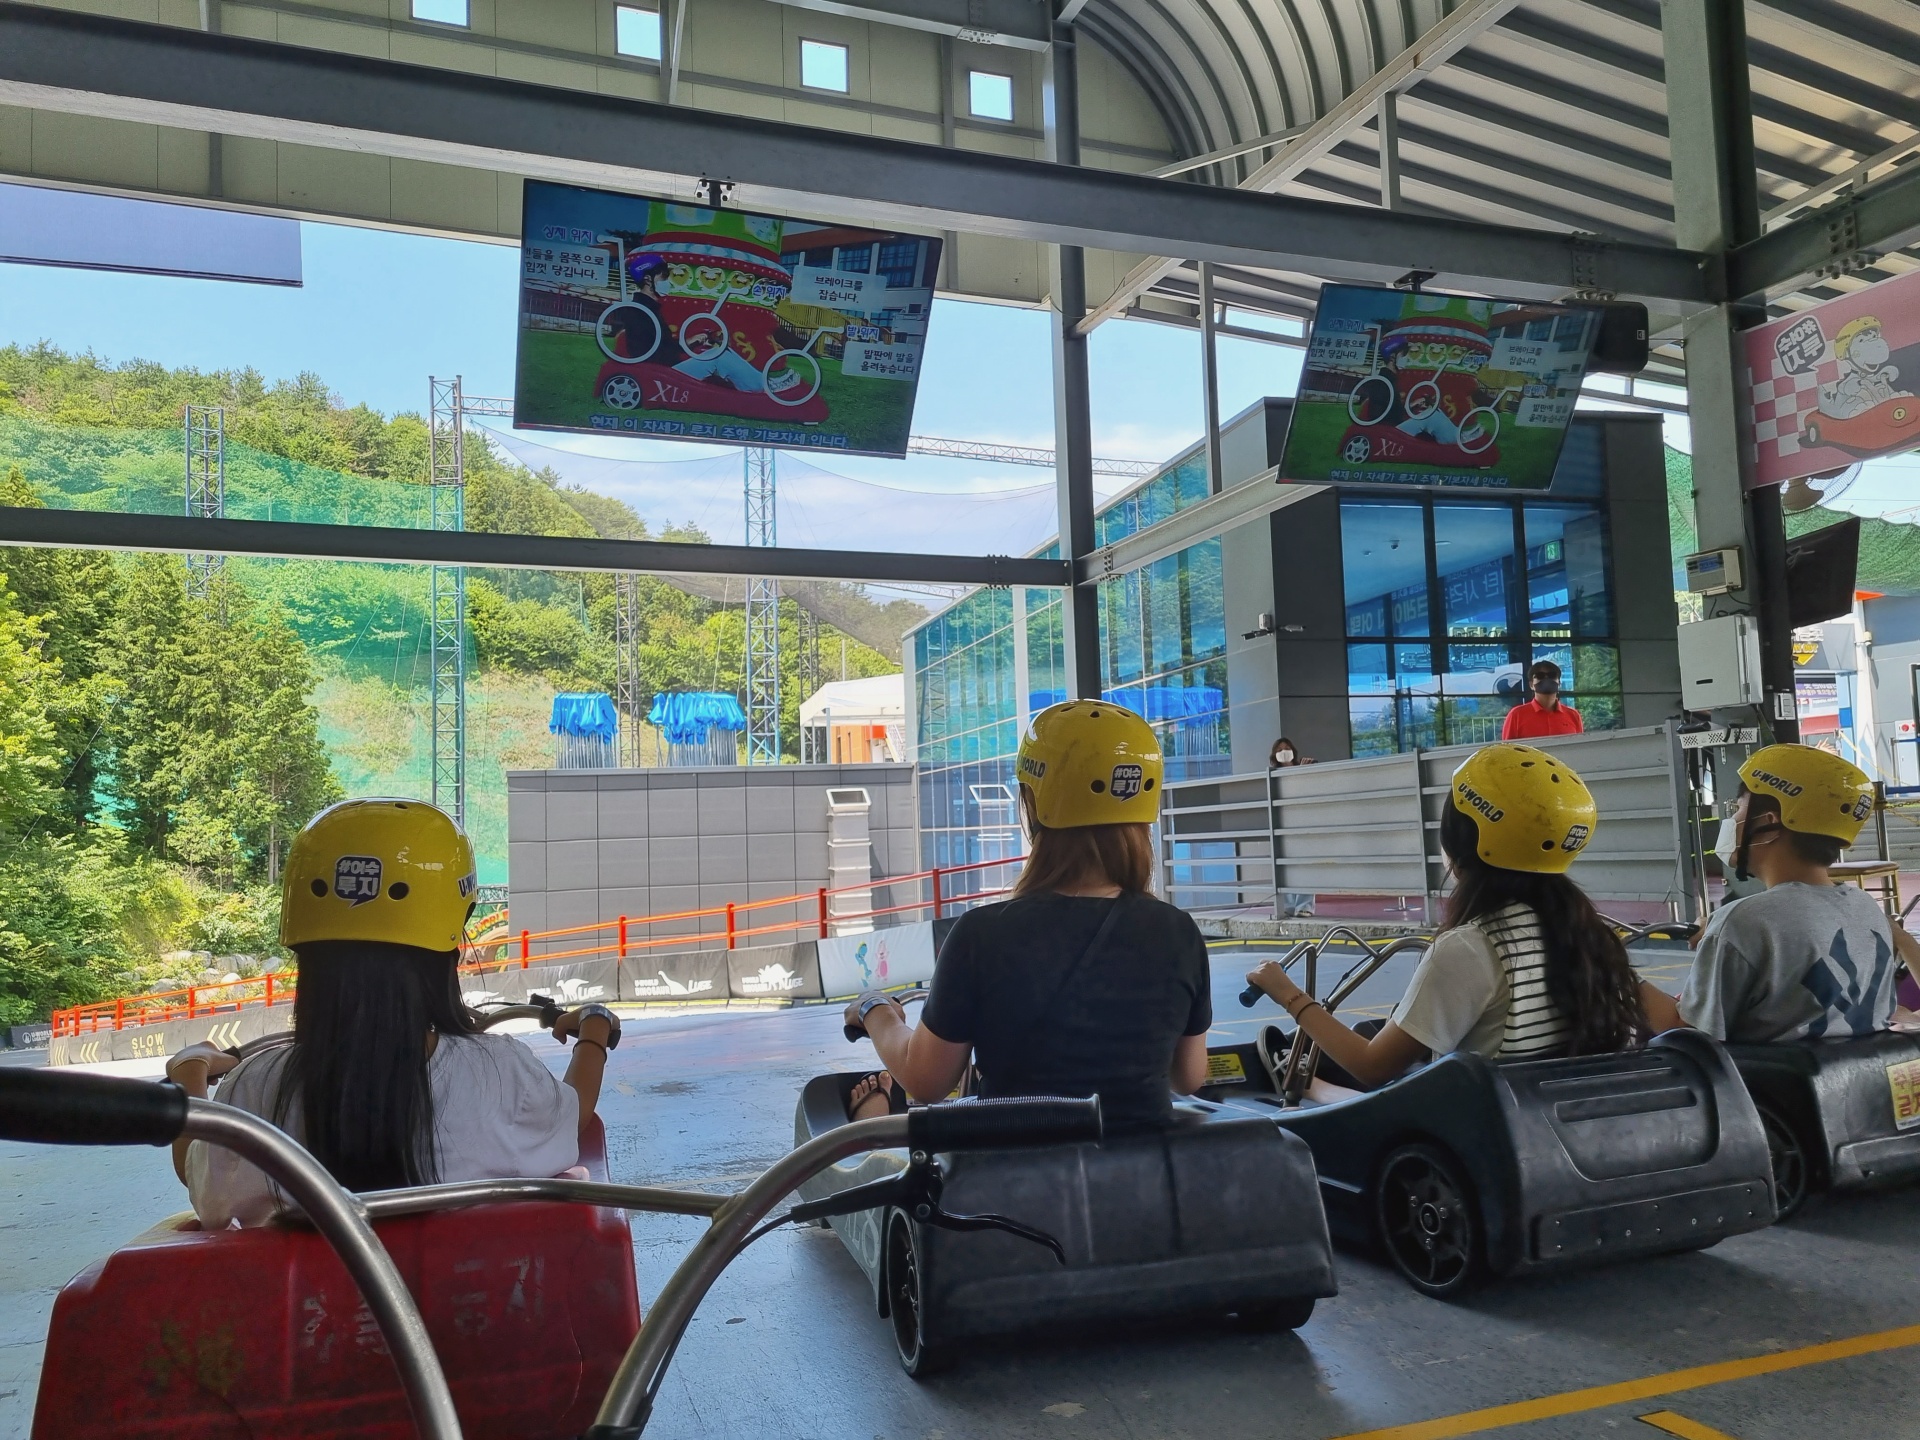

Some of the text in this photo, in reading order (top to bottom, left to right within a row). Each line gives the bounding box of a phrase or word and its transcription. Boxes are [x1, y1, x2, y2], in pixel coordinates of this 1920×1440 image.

[543, 225, 593, 244] 상체 위치
[559, 251, 604, 266] 몸쪽으로
[525, 261, 598, 281] 힘껏 당깁니다.
[752, 284, 787, 300] 손 위치
[814, 275, 864, 292] 브레이크를
[818, 289, 860, 304] 잡습니다.
[847, 325, 880, 341] 발 위치
[863, 349, 915, 364] 발판에 발을
[648, 380, 690, 404] XL8
[590, 415, 619, 430] 현재
[624, 418, 638, 431] 이
[642, 420, 686, 435] 자세가
[690, 423, 717, 438] 루지
[721, 426, 750, 440] 주행
[1374, 437, 1404, 457] XL8
[1114, 767, 1141, 779] #여수
[1112, 779, 1139, 794] 루지
[338, 859, 380, 877] #여수
[337, 876, 379, 897] 루지
[131, 1032, 164, 1050] SLOW
